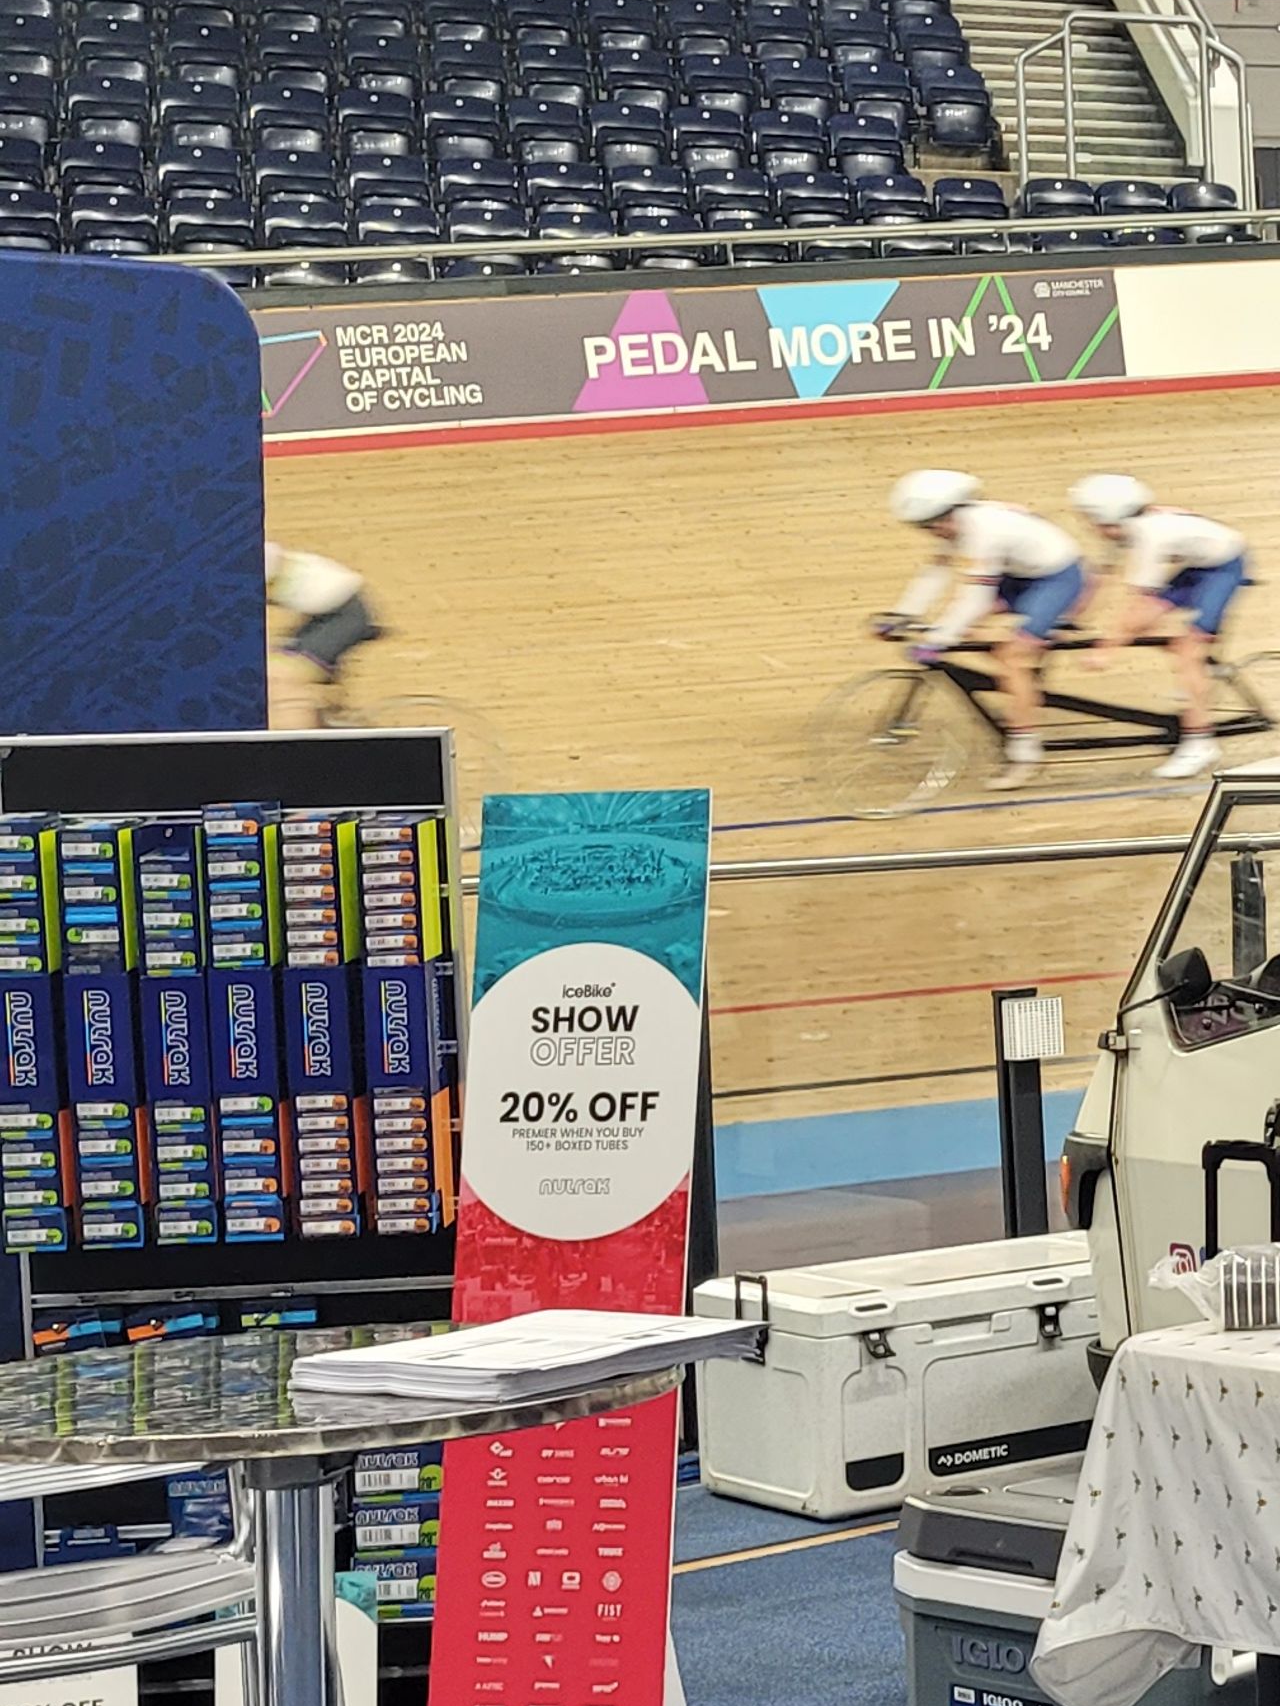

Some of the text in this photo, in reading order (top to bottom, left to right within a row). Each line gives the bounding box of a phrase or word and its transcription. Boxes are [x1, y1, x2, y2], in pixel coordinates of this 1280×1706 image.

[335, 321, 445, 347] MCR 2024
[583, 330, 757, 380] PEDAL
[768, 319, 916, 369] MORE
[927, 315, 976, 360] IN
[339, 341, 468, 368] EUROPEAN
[342, 365, 441, 390] CAPITAL
[346, 384, 483, 412] OF CYCLING
[232, 983, 258, 1078] nutrak
[306, 982, 332, 1077] nutrak
[385, 979, 411, 1074] nutrak
[530, 1004, 640, 1034] SHOW
[10, 991, 38, 1087] nutrak
[88, 989, 115, 1086] nutrak
[165, 990, 191, 1086] nutrak
[529, 1036, 636, 1067] OFFER
[499, 1091, 661, 1124] 20% OFF
[511, 1126, 645, 1140] PREMIER WHEN YOU BUY
[554, 1139, 593, 1151] BOXED
[595, 1139, 629, 1151] TUBES
[954, 1444, 1008, 1465] DOMETIC
